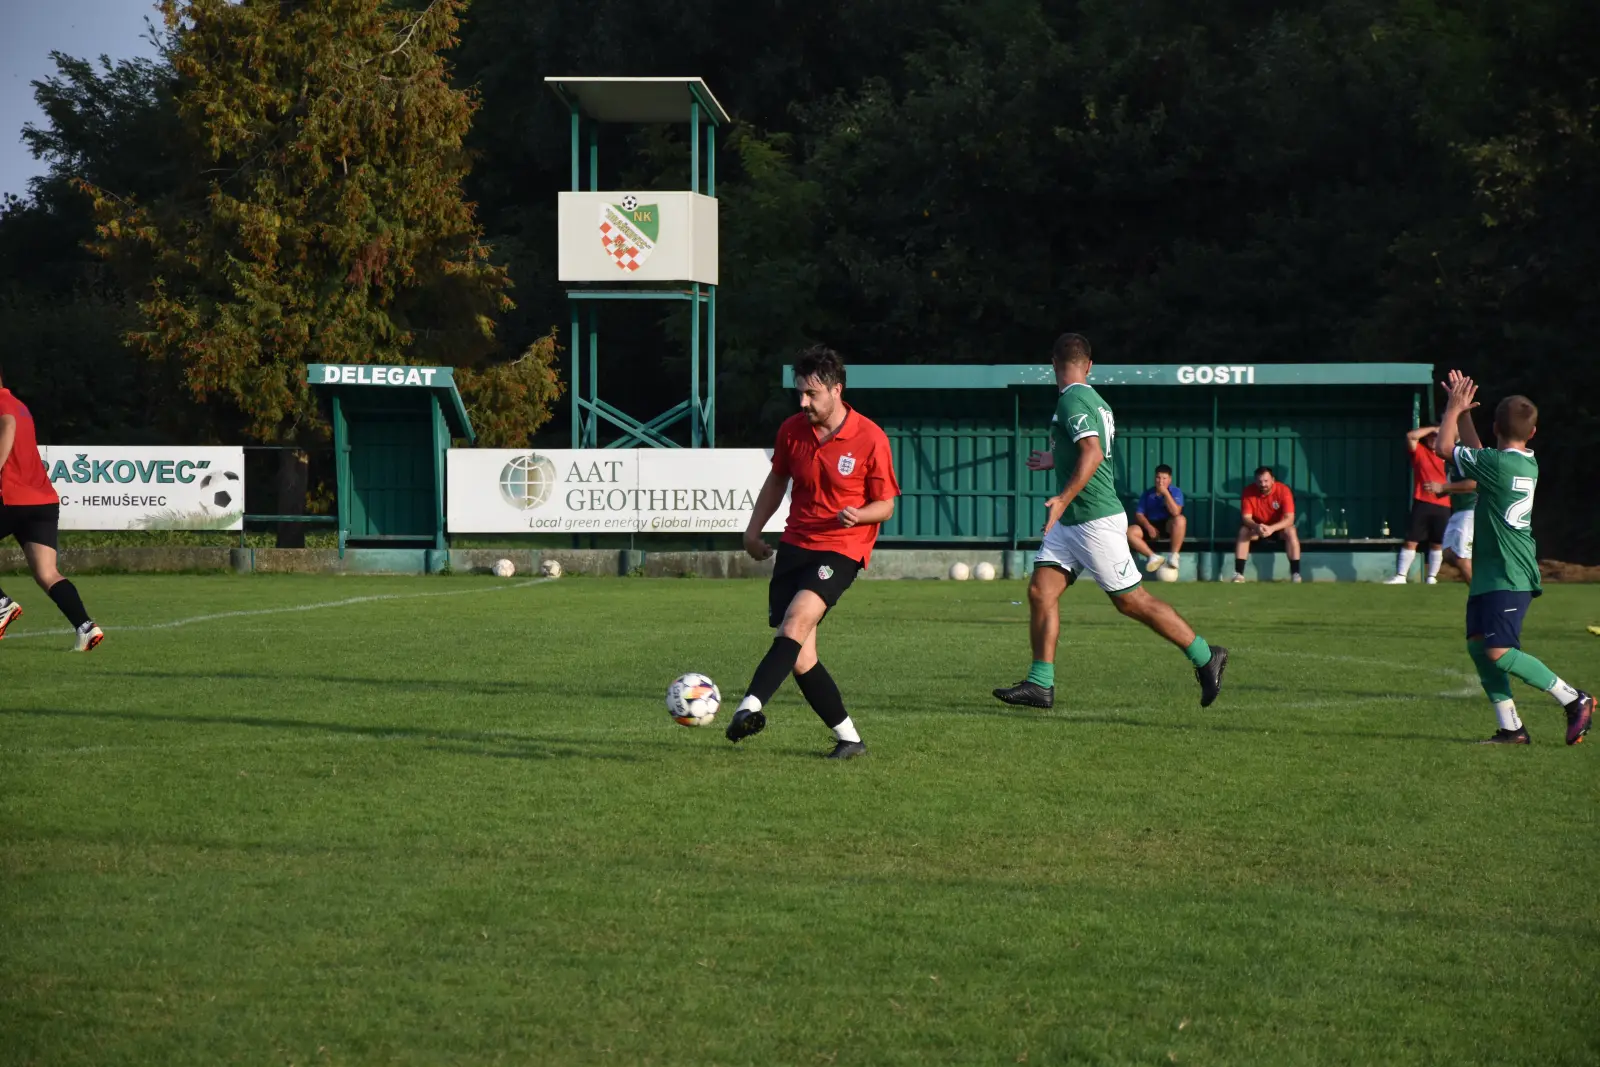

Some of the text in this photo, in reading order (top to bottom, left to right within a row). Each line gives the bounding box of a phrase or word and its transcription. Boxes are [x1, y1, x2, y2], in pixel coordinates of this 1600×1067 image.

[634, 211, 652, 222] NK
[324, 365, 436, 386] DELEGAT
[1177, 366, 1254, 384] GOSTI
[564, 461, 623, 483] AAT
[82, 493, 167, 506] HEMUŠEVEC
[565, 489, 761, 512] GEOTHERMA
[1504, 476, 1536, 529] 2
[529, 516, 738, 530] Local green energy Global impact
